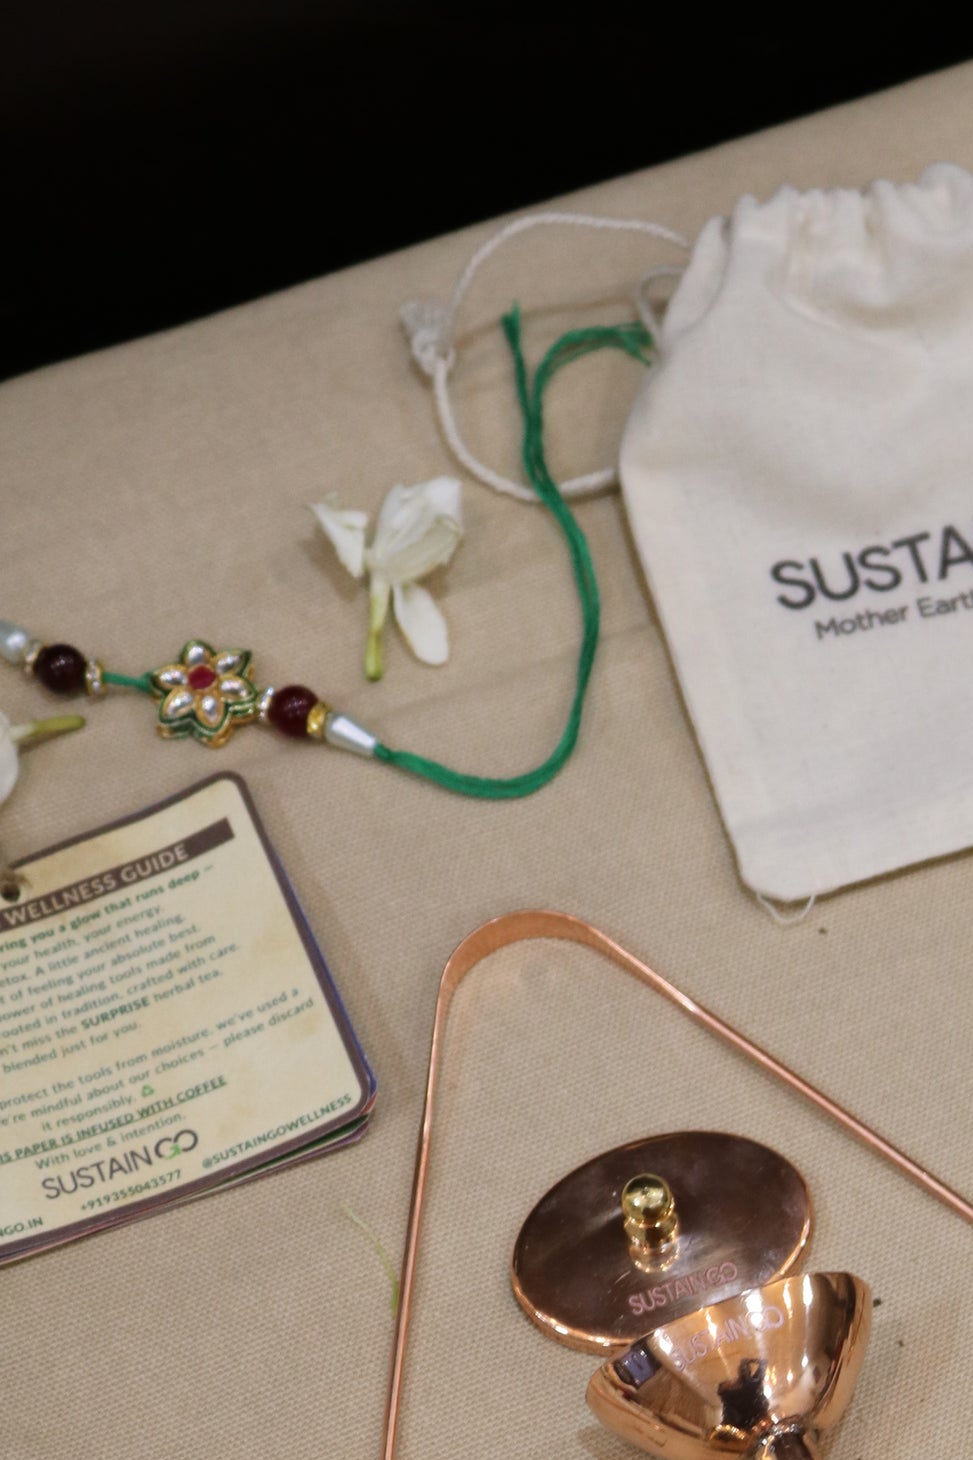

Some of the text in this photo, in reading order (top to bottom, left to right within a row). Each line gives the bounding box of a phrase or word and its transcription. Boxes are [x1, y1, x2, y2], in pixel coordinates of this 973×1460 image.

[813, 603, 909, 640] Mother
[0, 937, 27, 953] ring
[30, 928, 55, 944] you
[70, 909, 101, 930] glow
[104, 897, 131, 915] that
[136, 885, 164, 902] runs
[168, 870, 201, 890] deep
[3, 842, 189, 926] WELLNESS GUIDE
[0, 973, 31, 988] etox.
[48, 955, 79, 972] little
[84, 933, 131, 959] ancient
[10, 988, 23, 1001] of
[27, 975, 74, 996] feeling
[77, 963, 105, 980] your
[111, 938, 165, 966] absolute
[84, 924, 112, 942] your
[0, 935, 216, 1021] ower of healing tools made from
[0, 1018, 41, 1038] ooted
[45, 1014, 58, 1025] in
[126, 968, 174, 995] crafted
[178, 956, 206, 974] with
[22, 1034, 52, 1050] miss
[55, 1025, 78, 1039] the
[81, 995, 150, 1029] SURPRISE
[153, 976, 195, 1002] herbal
[0, 1112, 26, 1126] e're
[30, 1093, 82, 1117] mindful
[87, 1079, 124, 1101] about
[128, 1070, 151, 1084] our
[154, 1049, 206, 1076] choices
[222, 1022, 265, 1048] please
[268, 997, 315, 1027] discard
[3, 1047, 57, 1073] blended
[61, 1040, 87, 1058] just
[90, 1032, 108, 1046] for
[52, 1079, 75, 1094] the
[78, 1066, 112, 1085] tools
[115, 1051, 148, 1071] from
[216, 1008, 255, 1032] we've
[256, 995, 288, 1014] used
[14, 1138, 58, 1159] PAPER
[60, 1132, 74, 1146] IS
[76, 1113, 134, 1141] INFUSED
[137, 1098, 174, 1121] WITH
[176, 1075, 228, 1104] COFFEE
[41, 1120, 53, 1132] it
[201, 1093, 353, 1170] @SUSTAINGOWELLNESS
[34, 1152, 70, 1170] With
[73, 1143, 102, 1159] love
